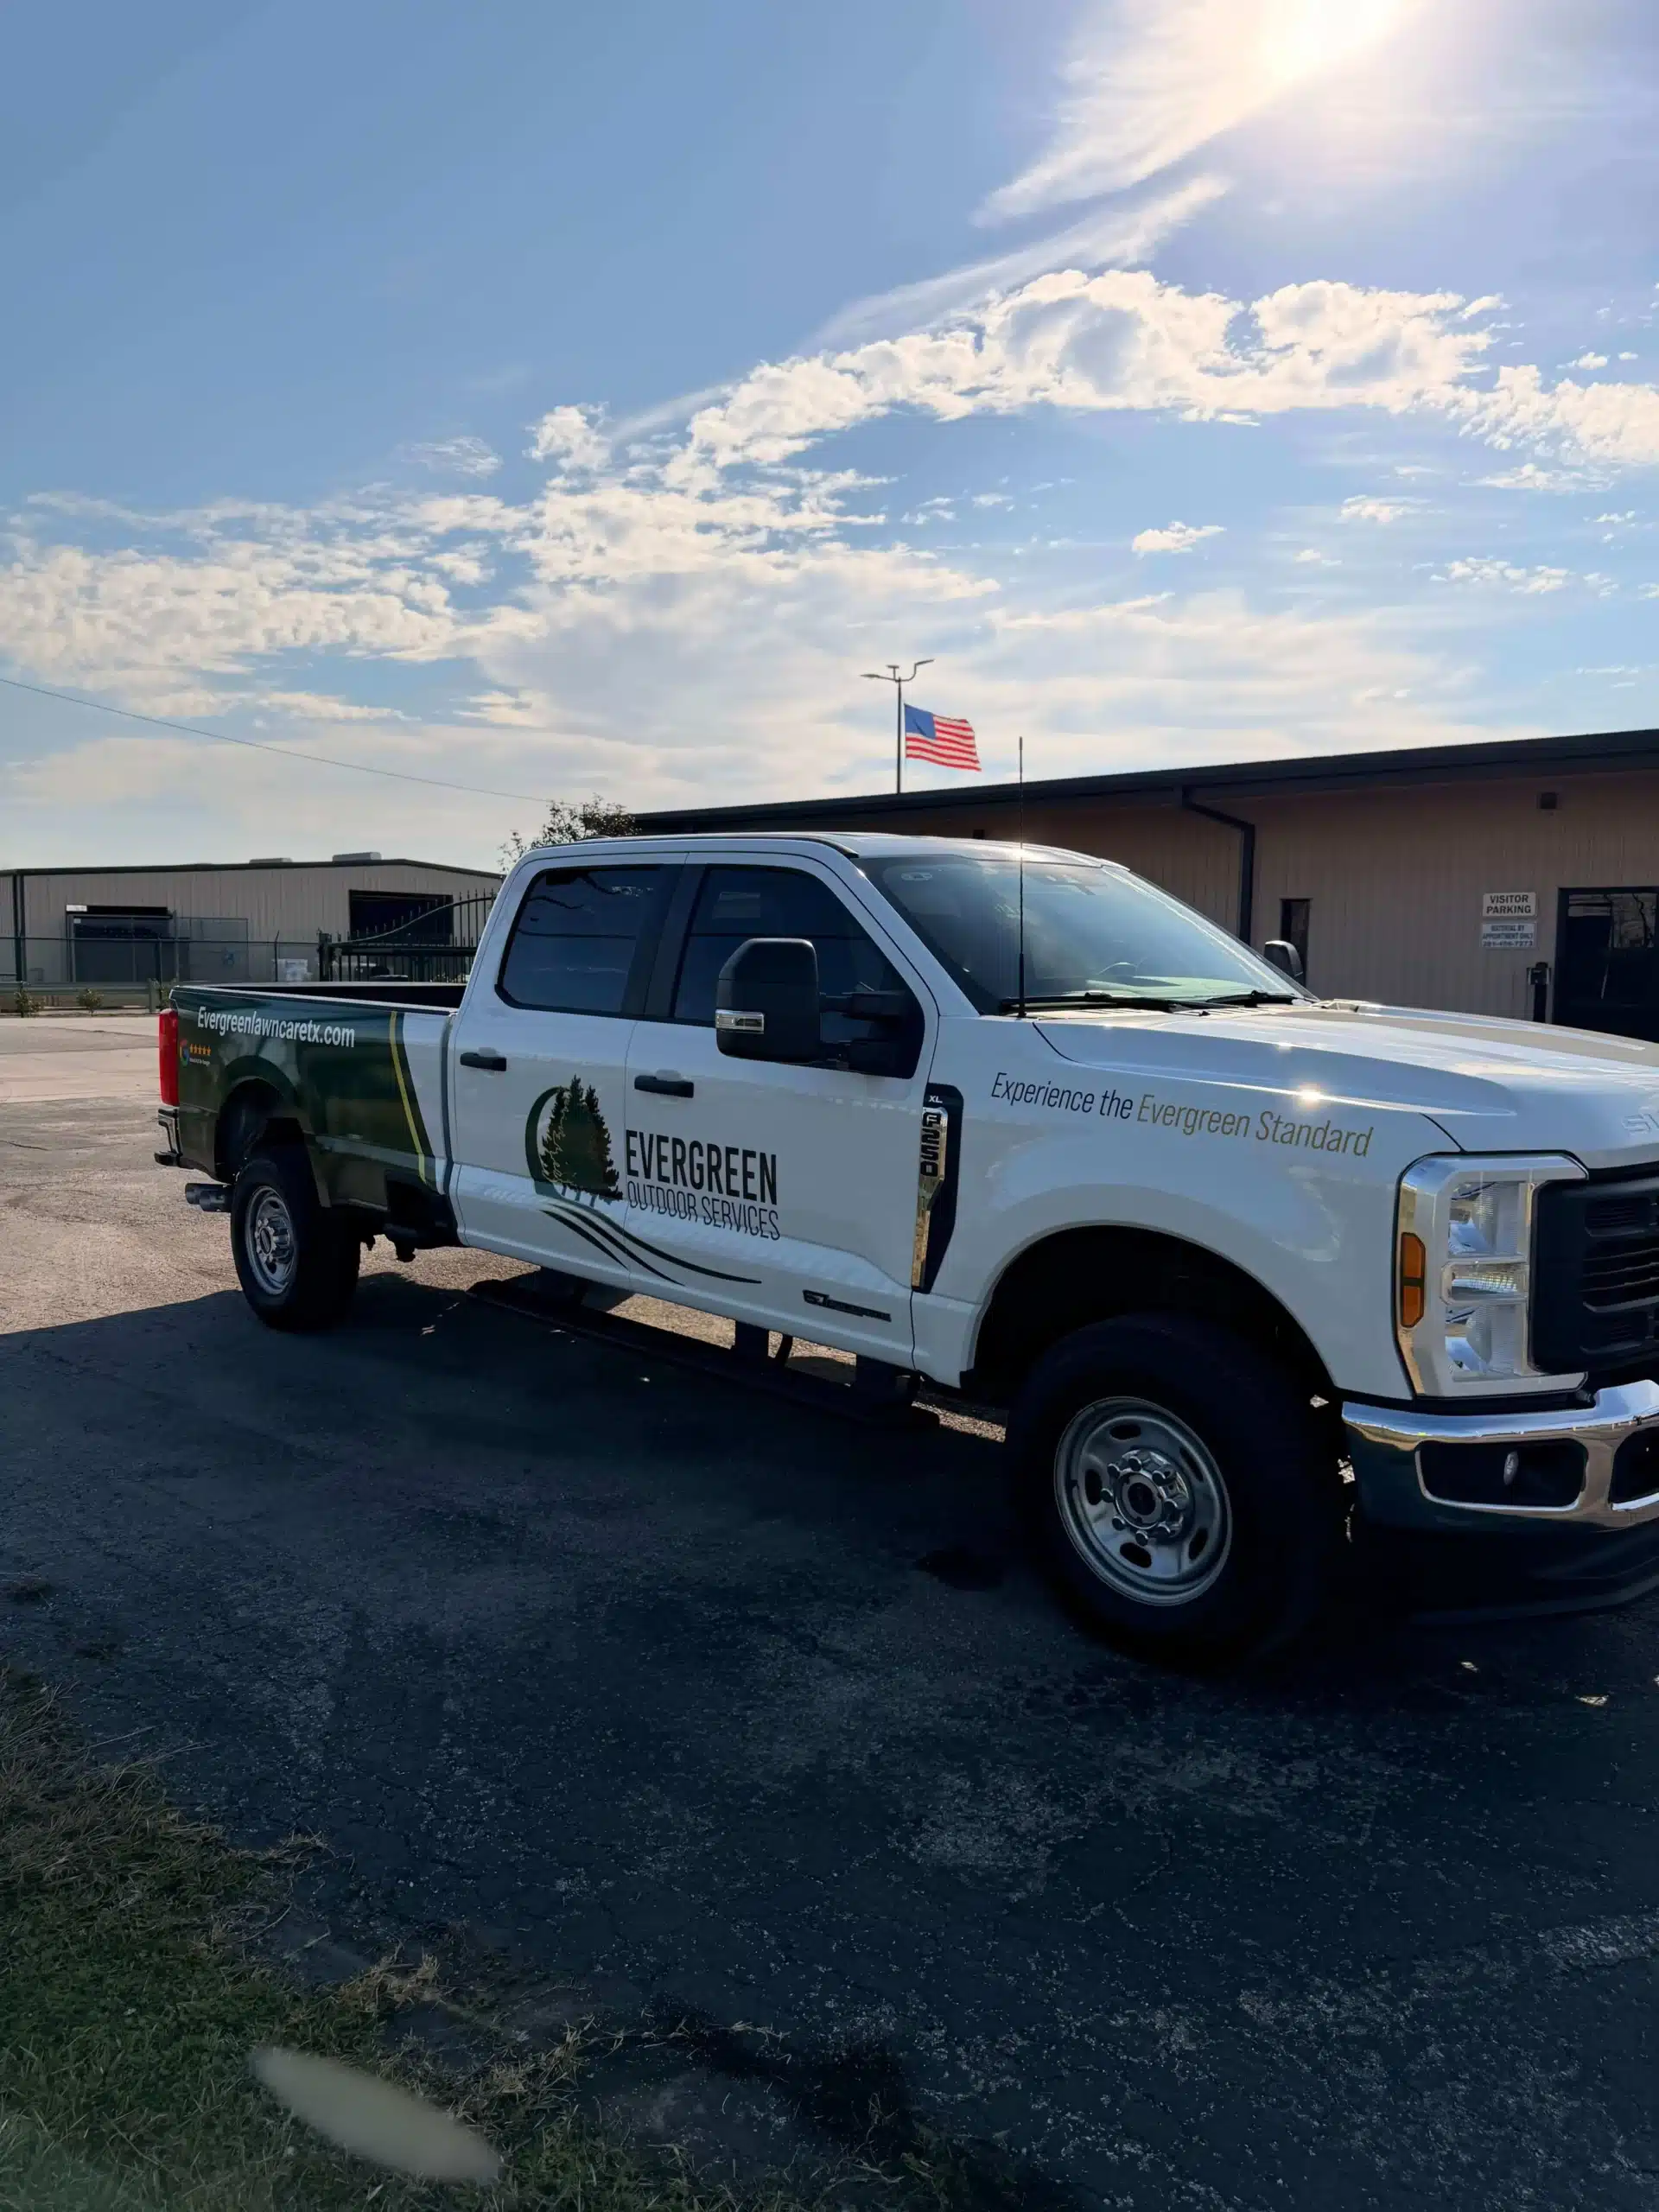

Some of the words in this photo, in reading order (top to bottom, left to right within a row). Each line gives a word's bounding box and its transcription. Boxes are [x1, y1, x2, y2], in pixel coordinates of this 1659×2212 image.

[1486, 906, 1531, 914] PARKING
[1490, 894, 1529, 904] VISITOR
[197, 1006, 356, 1048] Evergreenlawncaretx.com
[928, 1095, 943, 1103] XL
[990, 1072, 1095, 1113] Experience
[1099, 1090, 1133, 1120] the
[1136, 1094, 1250, 1137] Evergreen
[1255, 1110, 1374, 1157] Standard
[626, 1129, 777, 1205] EVERGREEN
[627, 1180, 698, 1223] OUTDOOR
[702, 1196, 780, 1241] SERVICES
